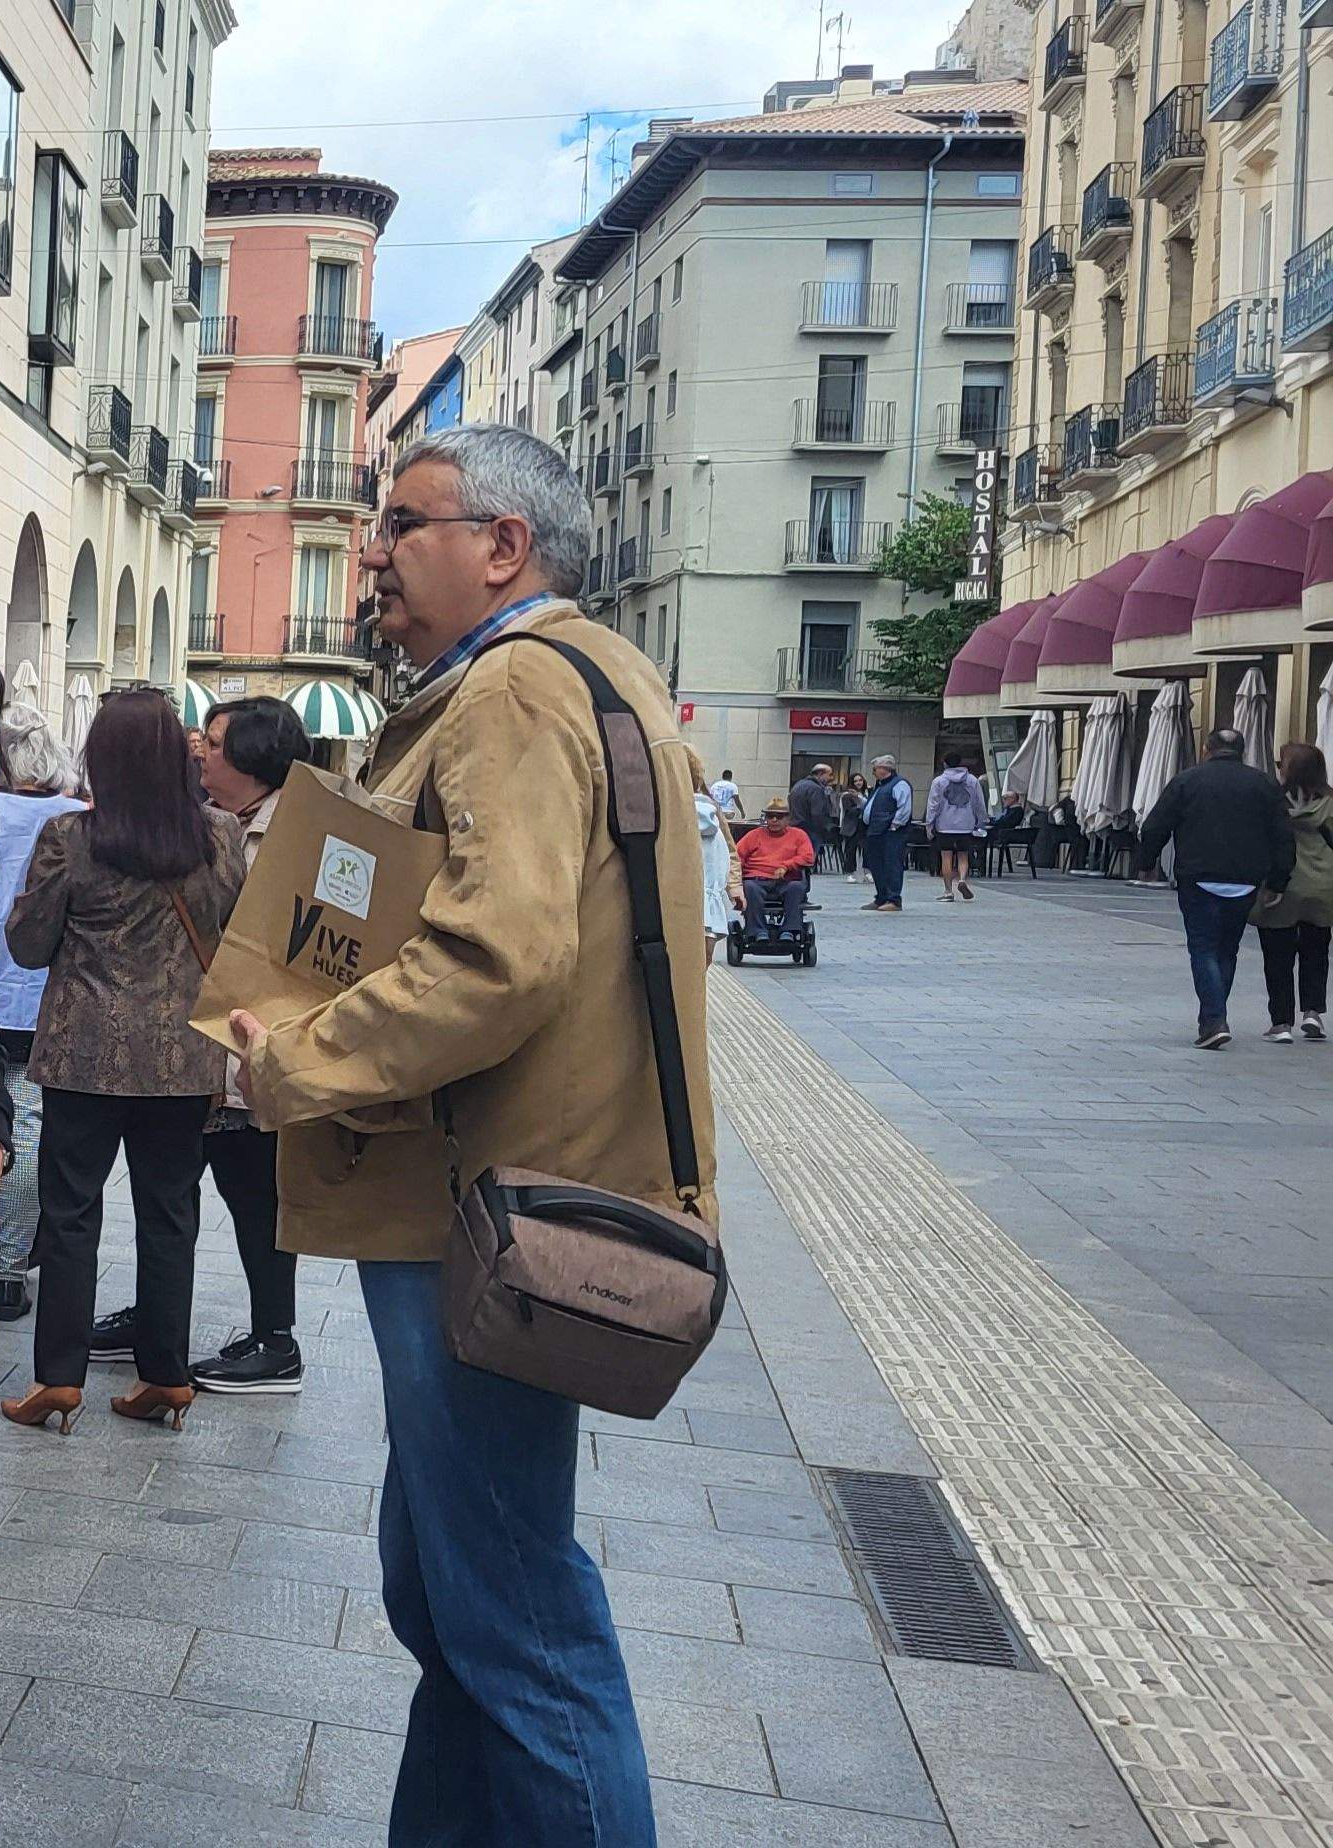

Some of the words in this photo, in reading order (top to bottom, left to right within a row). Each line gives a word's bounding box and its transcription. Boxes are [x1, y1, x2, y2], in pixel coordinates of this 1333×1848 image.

[970, 450, 995, 577] HOSTAL
[954, 580, 988, 601] RUGACA
[811, 715, 846, 728] GAES
[313, 954, 362, 988] HUES
